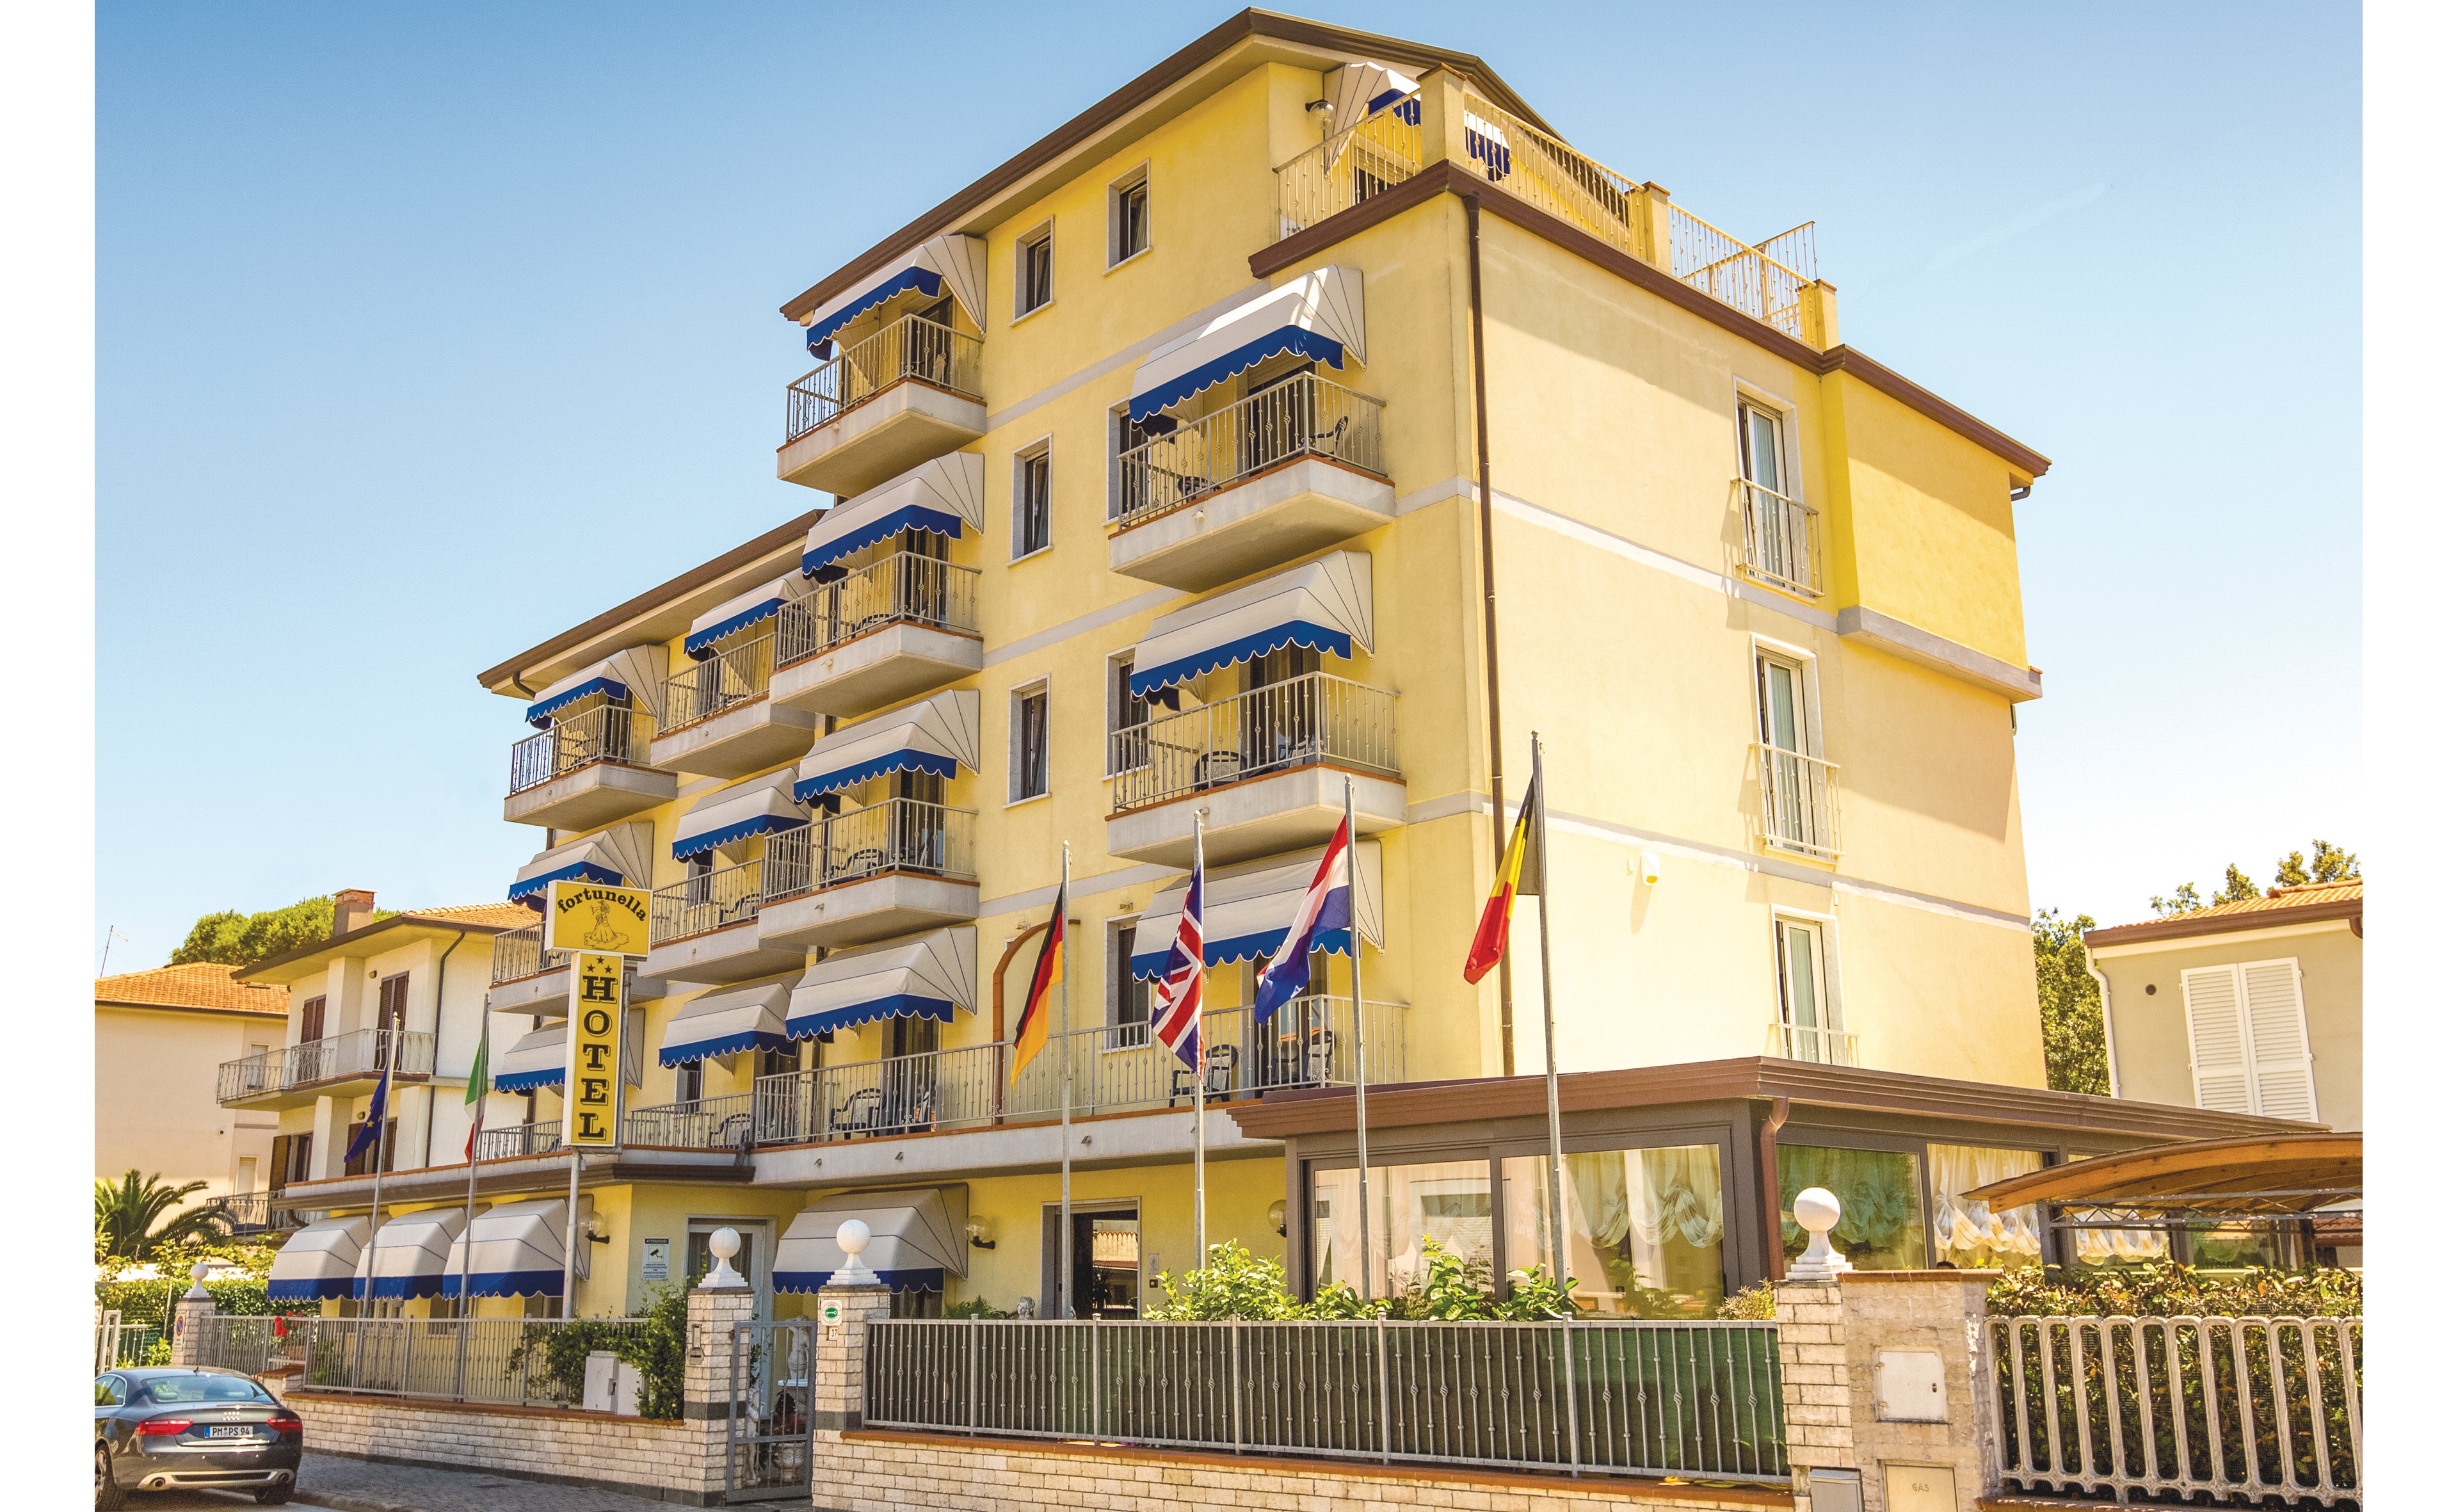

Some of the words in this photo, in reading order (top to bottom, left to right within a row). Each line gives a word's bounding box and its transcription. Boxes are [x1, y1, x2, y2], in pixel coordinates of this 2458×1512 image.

[558, 888, 646, 921] fortunella
[578, 976, 618, 1140] HOTEL
[831, 1329, 837, 1337] 37
[229, 1428, 238, 1436] PS
[1912, 1483, 1929, 1492] GAS
